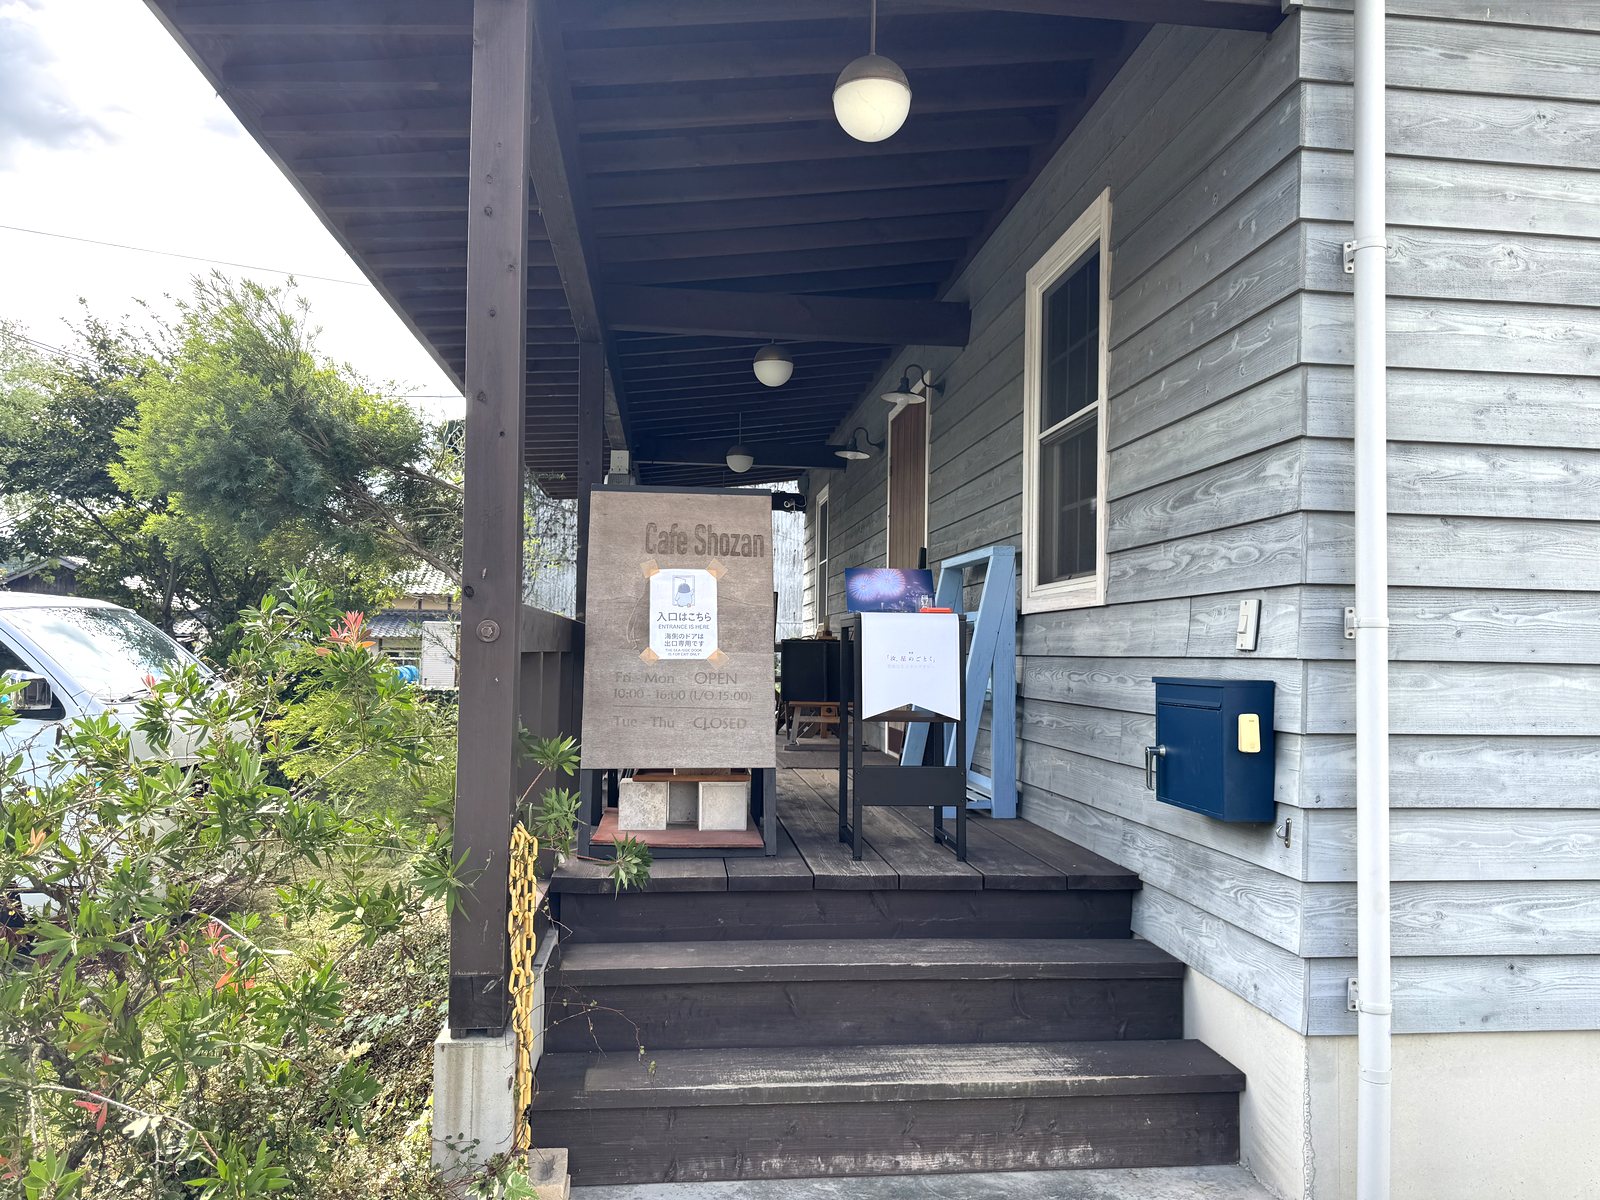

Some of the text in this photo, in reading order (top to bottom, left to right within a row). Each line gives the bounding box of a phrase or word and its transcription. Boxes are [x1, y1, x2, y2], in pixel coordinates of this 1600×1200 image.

[645, 522, 765, 557] Cafe Shozan
[656, 611, 712, 622] 入口はこちら
[664, 632, 704, 640] 海側のドアは
[615, 671, 631, 683] Fri
[644, 672, 675, 684] Mon
[694, 671, 738, 684] OPEN
[613, 688, 644, 699] 10:00
[656, 689, 686, 701] 16:00
[613, 715, 638, 727] Tue
[650, 716, 675, 728] Thu
[693, 716, 747, 731] CLOSED
